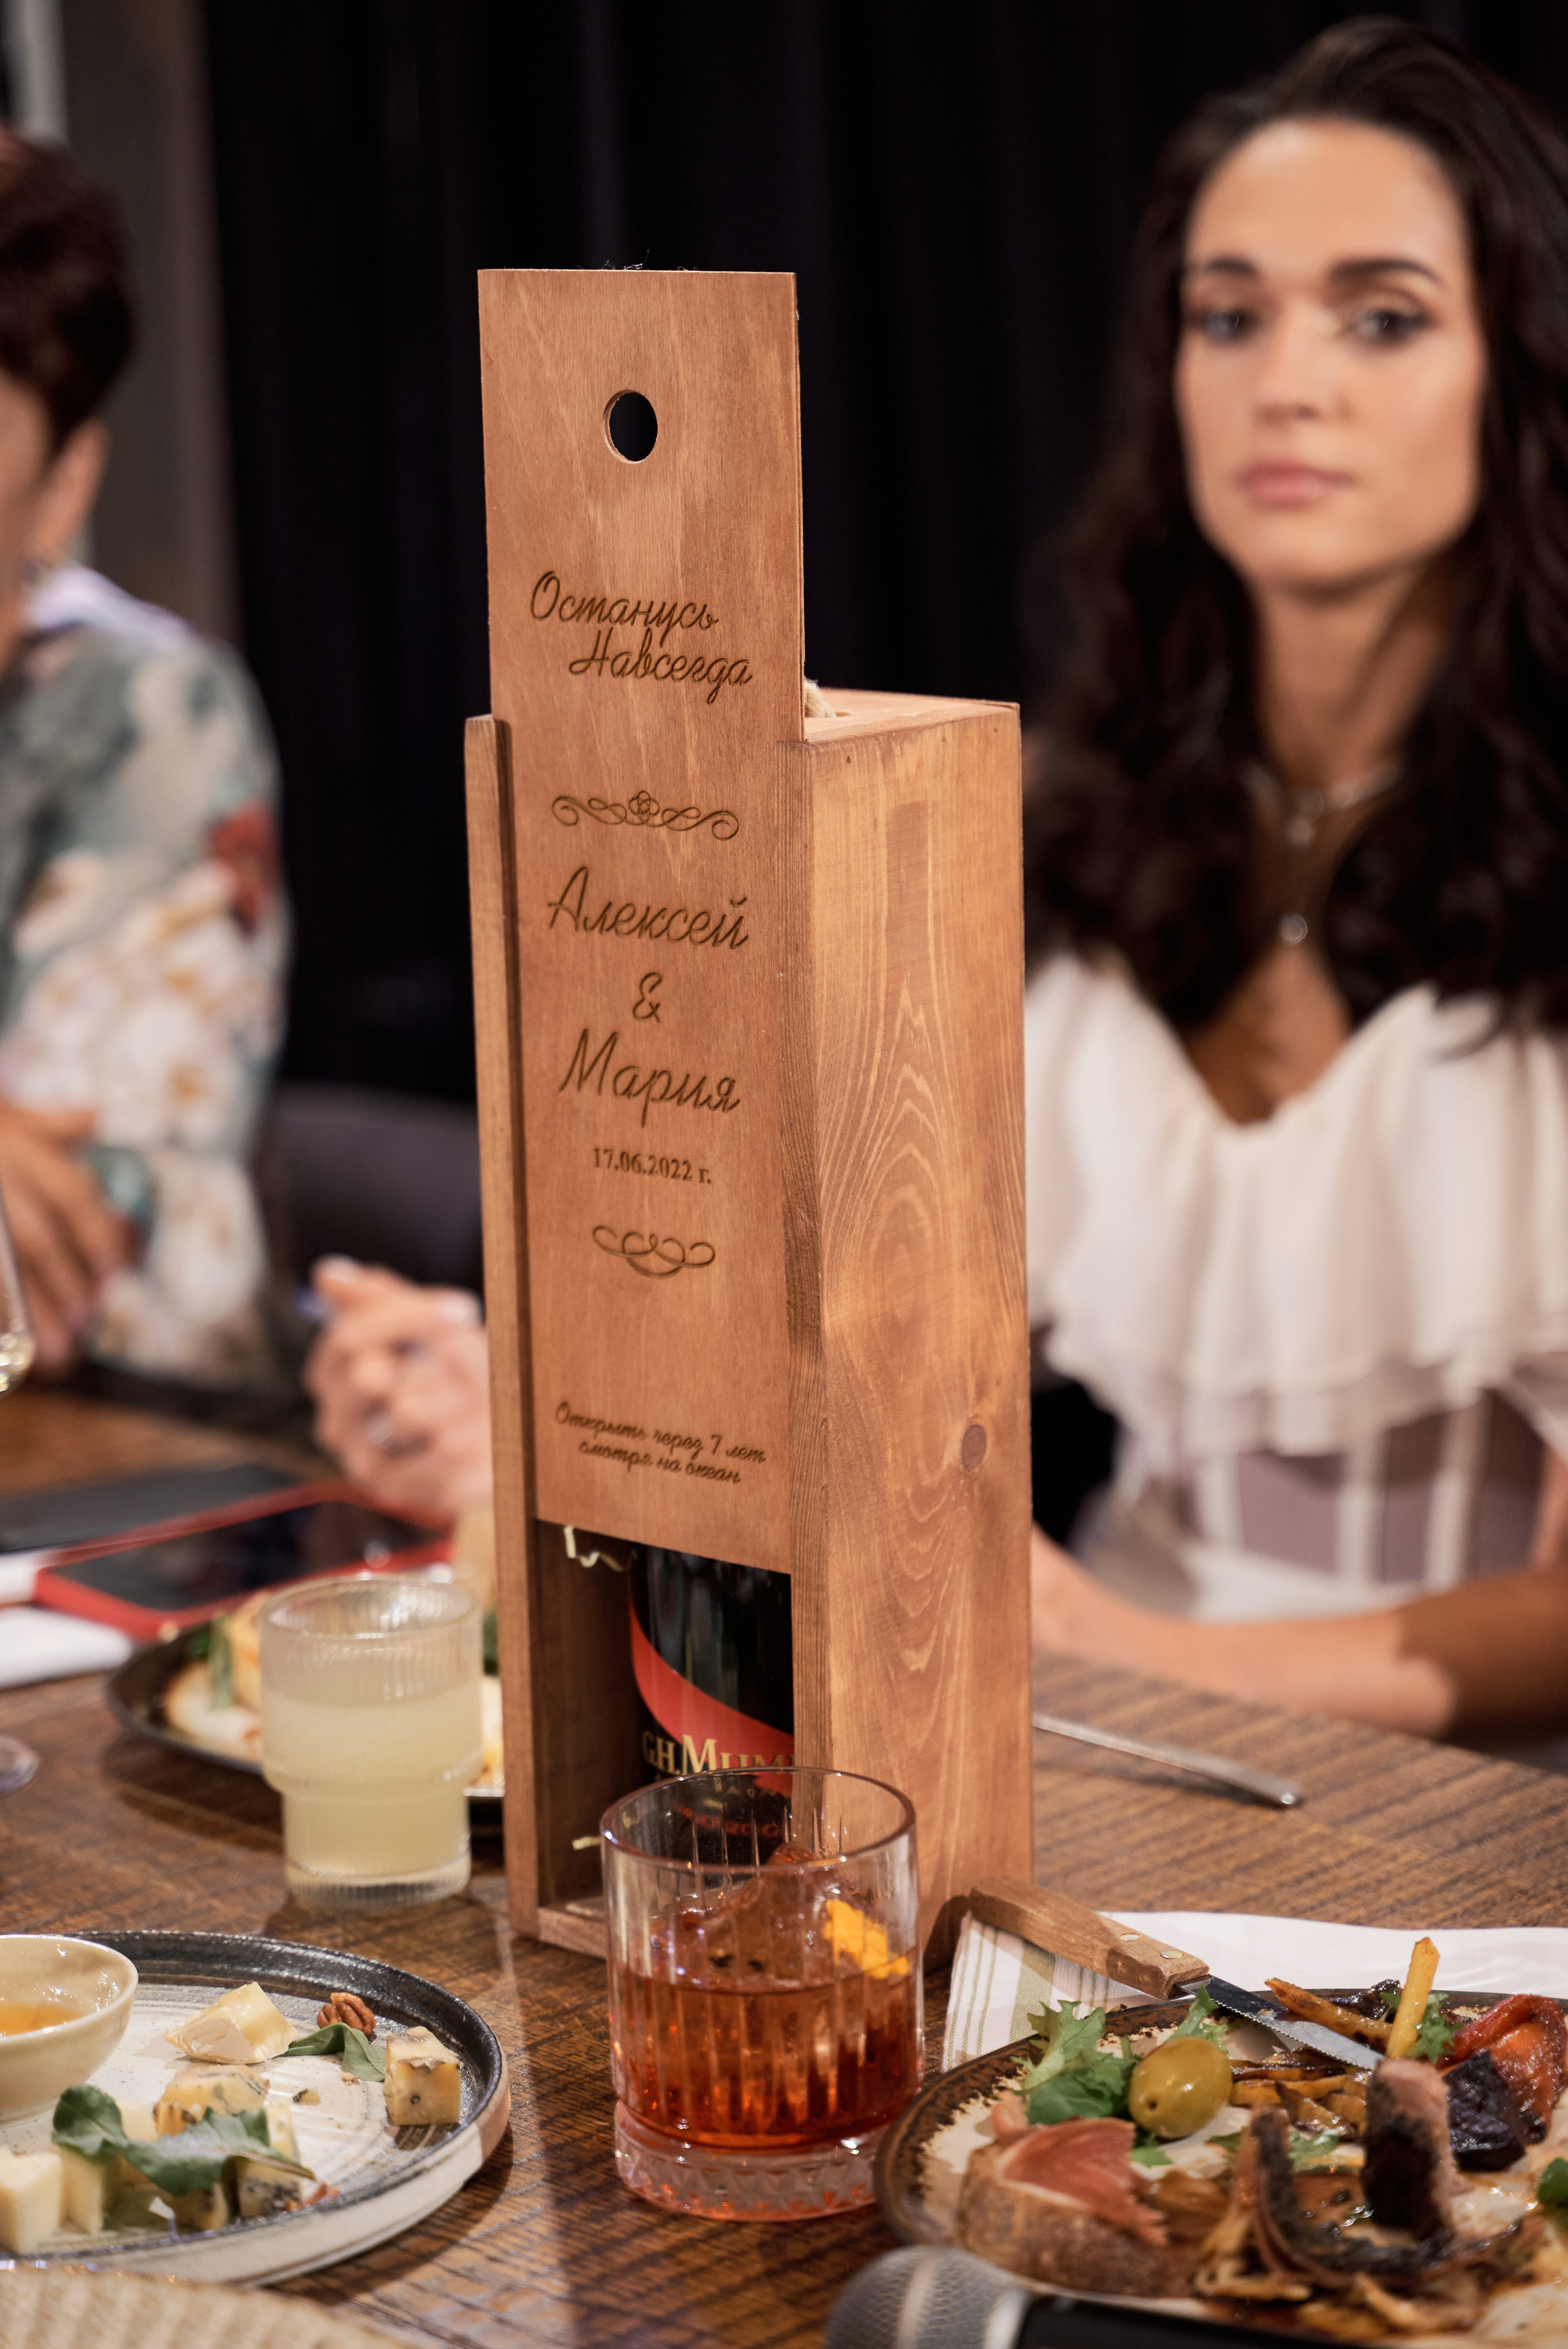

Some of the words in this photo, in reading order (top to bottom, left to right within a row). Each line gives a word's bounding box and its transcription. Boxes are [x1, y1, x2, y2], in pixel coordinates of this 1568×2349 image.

[530, 570, 719, 648] Останусь
[569, 627, 753, 705] Навсегда
[548, 866, 748, 949] Алексей
[632, 972, 663, 1023] &
[559, 1028, 741, 1129] Мария
[594, 1148, 692, 1182] 17.06.2022
[698, 1168, 712, 1185] г.
[653, 1428, 703, 1461] через
[710, 1434, 723, 1455] 7
[657, 1456, 682, 1472] на
